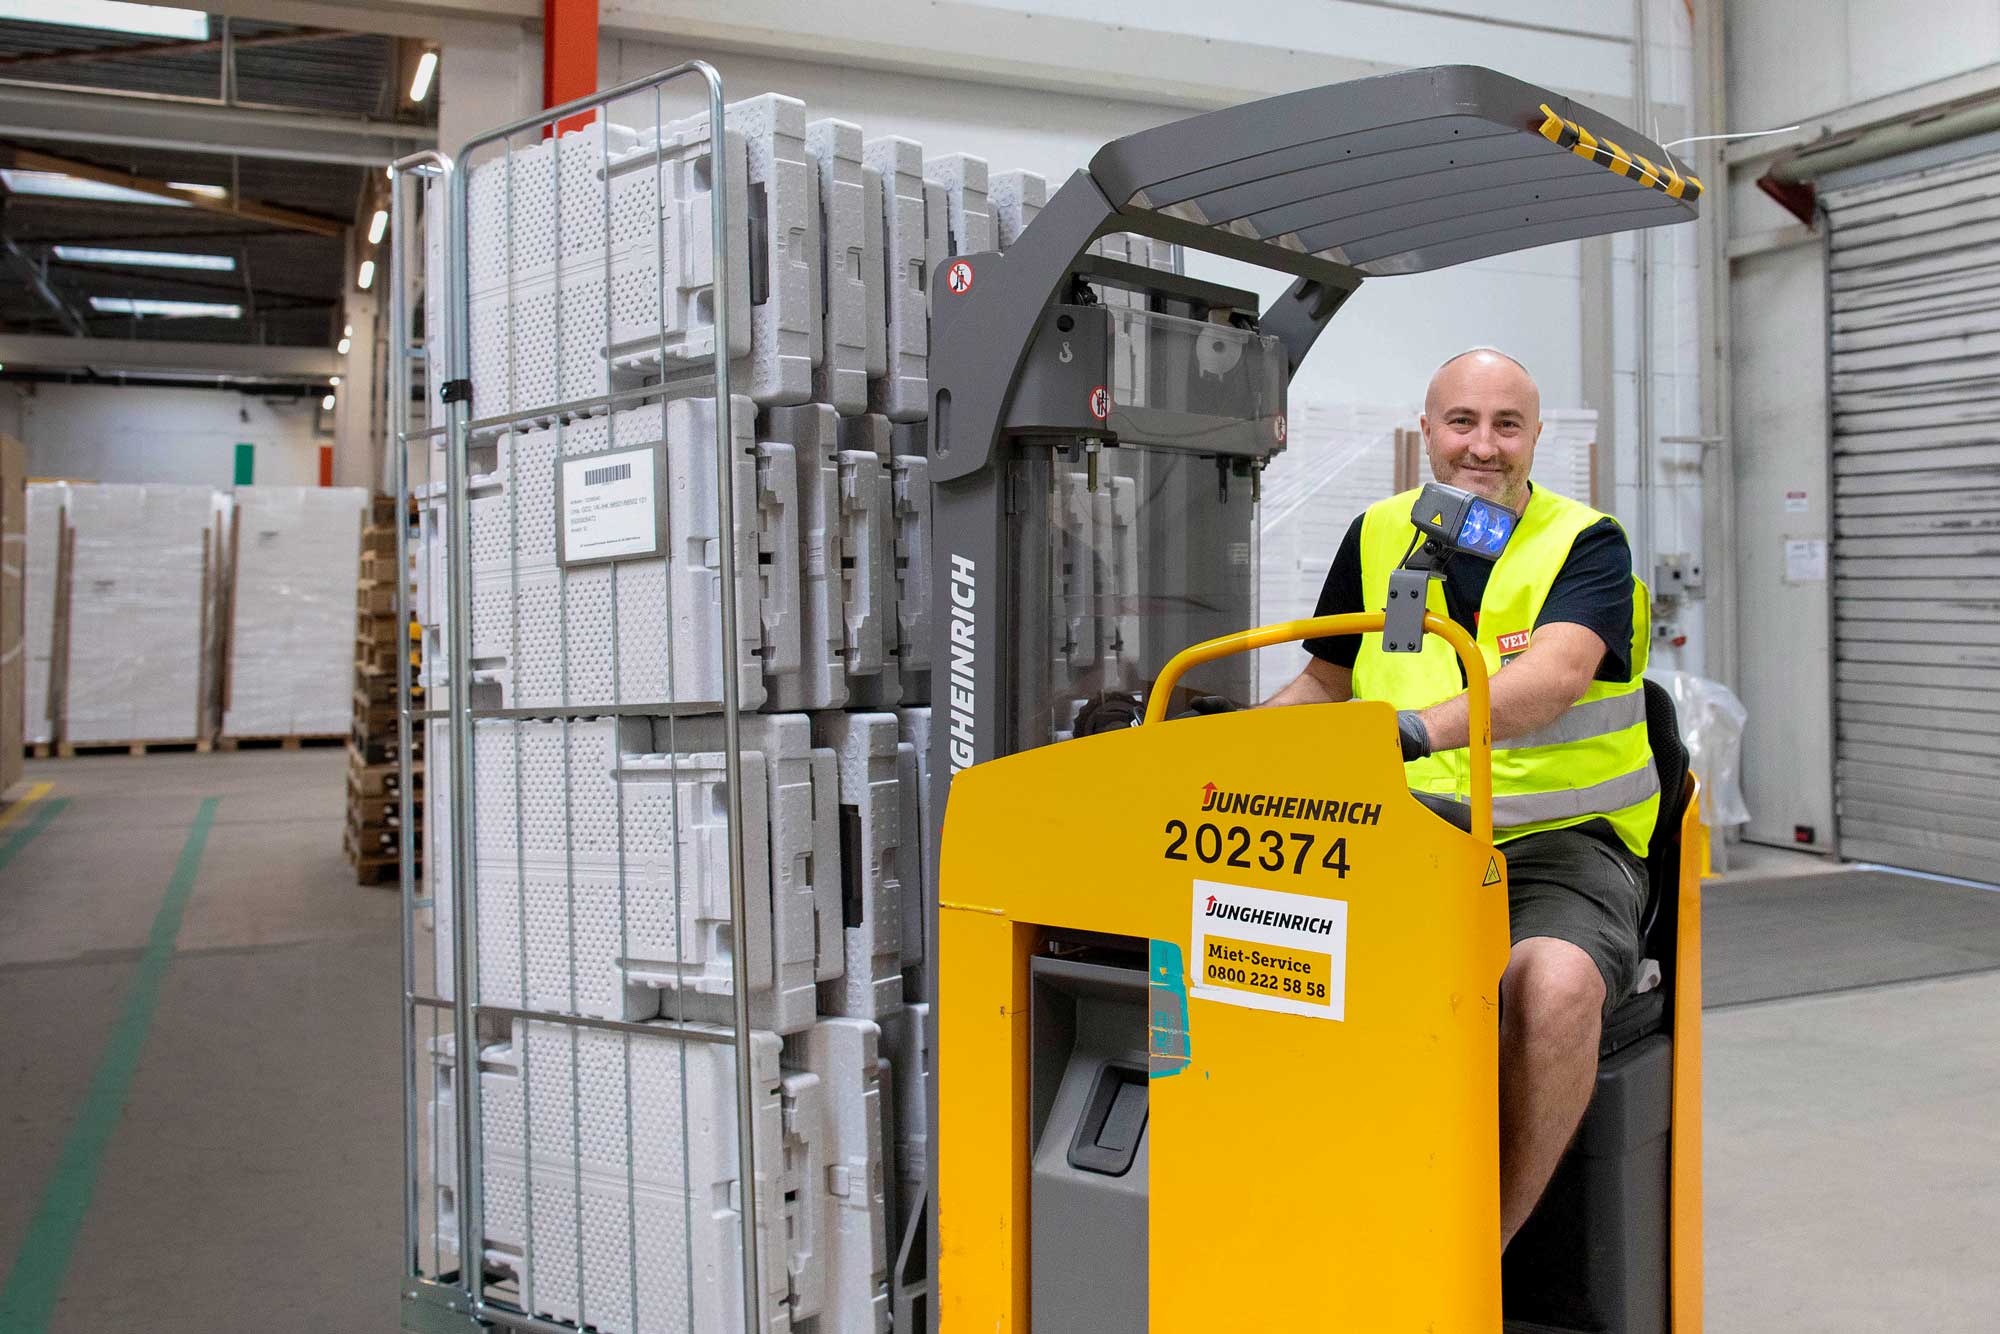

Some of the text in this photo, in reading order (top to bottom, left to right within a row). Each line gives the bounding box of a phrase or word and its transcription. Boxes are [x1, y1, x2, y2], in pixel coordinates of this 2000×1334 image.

[950, 553, 975, 776] GHEINRICH
[1201, 791, 1382, 826] JUNGHEINRICH
[1164, 819, 1351, 879] 202374
[1205, 902, 1333, 935] JUNGHEINRICH
[1208, 943, 1312, 974] Miet-Service
[1208, 964, 1326, 998] 0800 222 58 58
